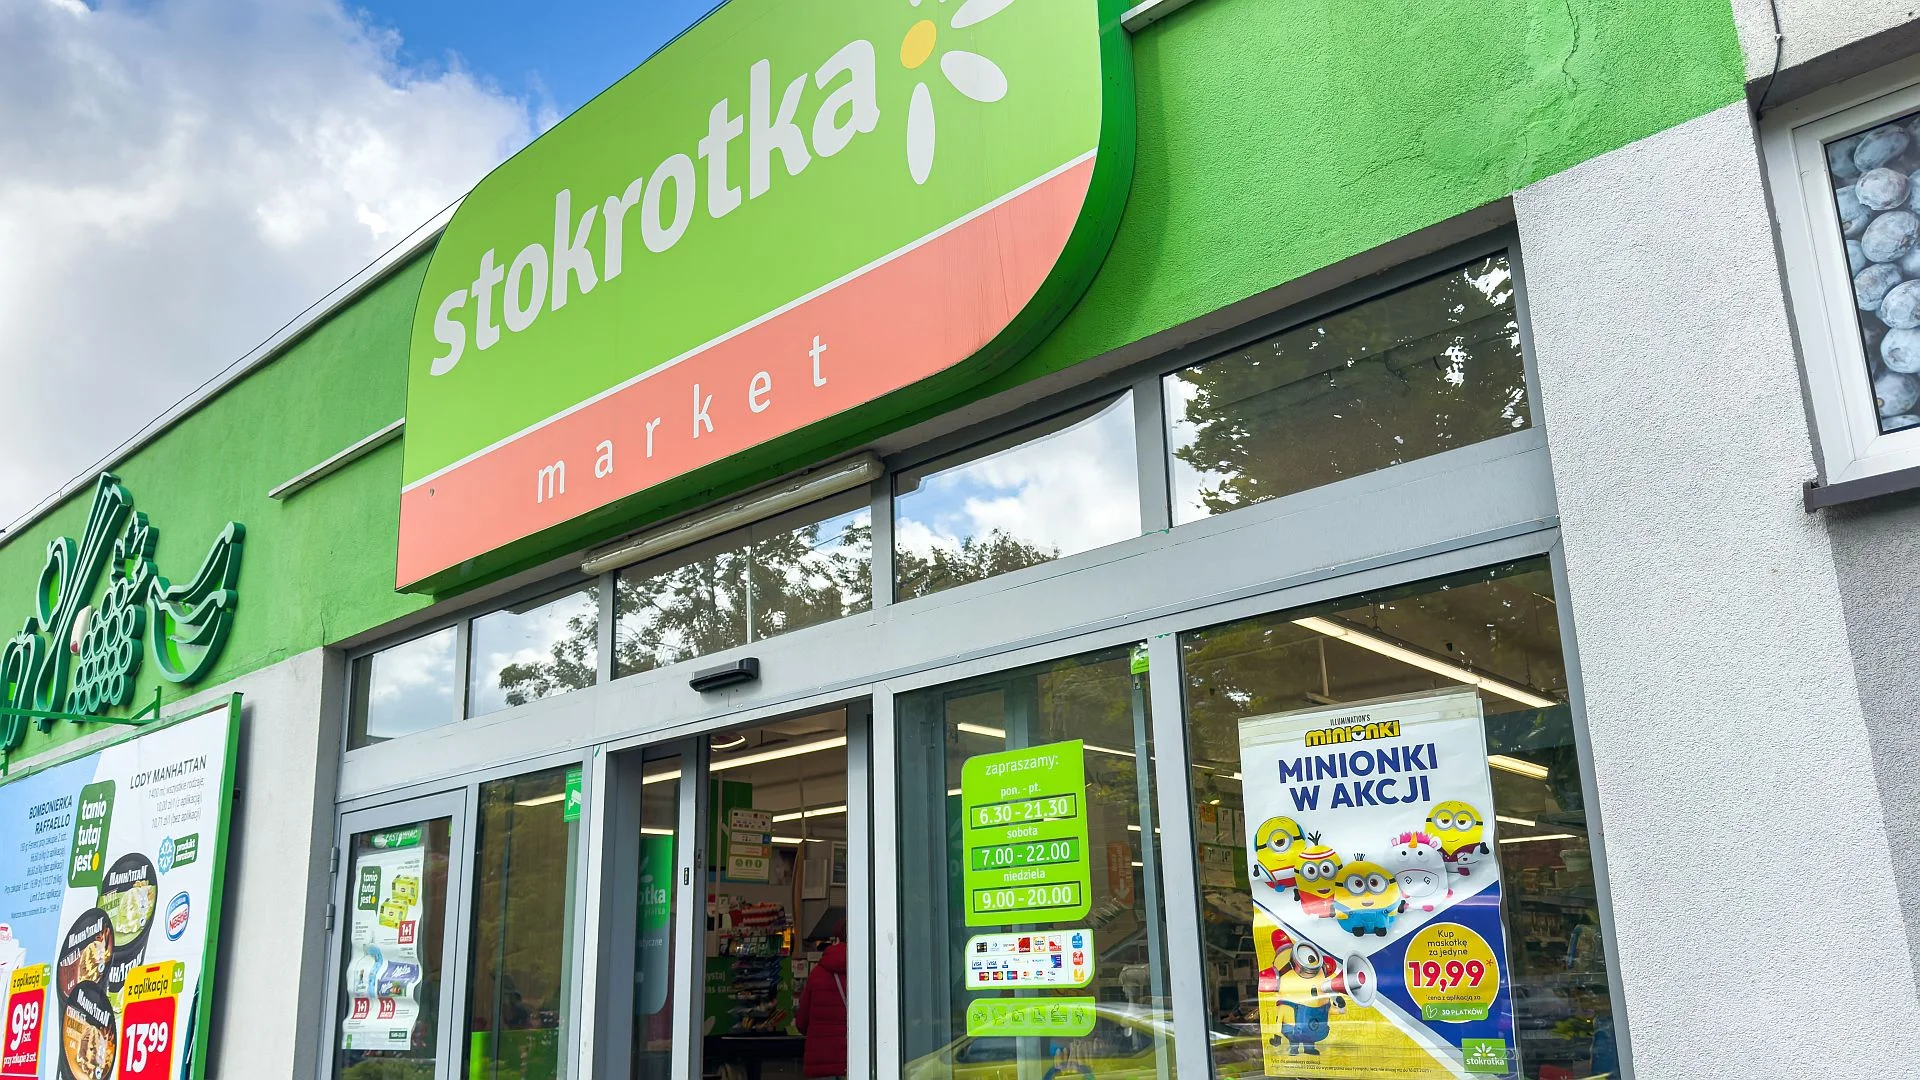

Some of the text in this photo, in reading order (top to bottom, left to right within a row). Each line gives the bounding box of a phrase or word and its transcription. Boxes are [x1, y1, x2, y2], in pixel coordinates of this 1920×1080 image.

[429, 39, 880, 376] stokrotka
[536, 335, 827, 503] market
[130, 755, 207, 789] LODY MANHATTAN
[985, 755, 1060, 776] zapraszamy:
[1278, 743, 1438, 784] MINIONKI
[1000, 786, 1021, 799] pon.
[1028, 782, 1041, 795] pt.
[1289, 775, 1431, 811] W AKCJI
[29, 795, 72, 819] BOMBONIERKA
[81, 793, 107, 820] tanio
[979, 805, 1012, 825] 6.30
[1024, 798, 1068, 820] 21.30
[35, 814, 70, 835] RAFFAELLO
[78, 818, 102, 851] tutaj
[1007, 827, 1038, 839] sobota
[981, 847, 1014, 866] 7.00
[1026, 841, 1070, 863] 22.00
[363, 871, 378, 883] tanio
[1003, 869, 1046, 882] niedziela
[361, 881, 376, 896] tutaj
[982, 891, 1015, 909] 9.00
[1027, 886, 1072, 907] 20.00
[401, 923, 413, 937] 1+1
[1437, 930, 1455, 938] Kup
[1427, 939, 1468, 949] maskotkę
[1439, 948, 1468, 957] jedyne
[18, 970, 41, 992] aplikacją
[128, 974, 169, 999] z aplikacją
[1466, 1057, 1505, 1067] stokrotka
